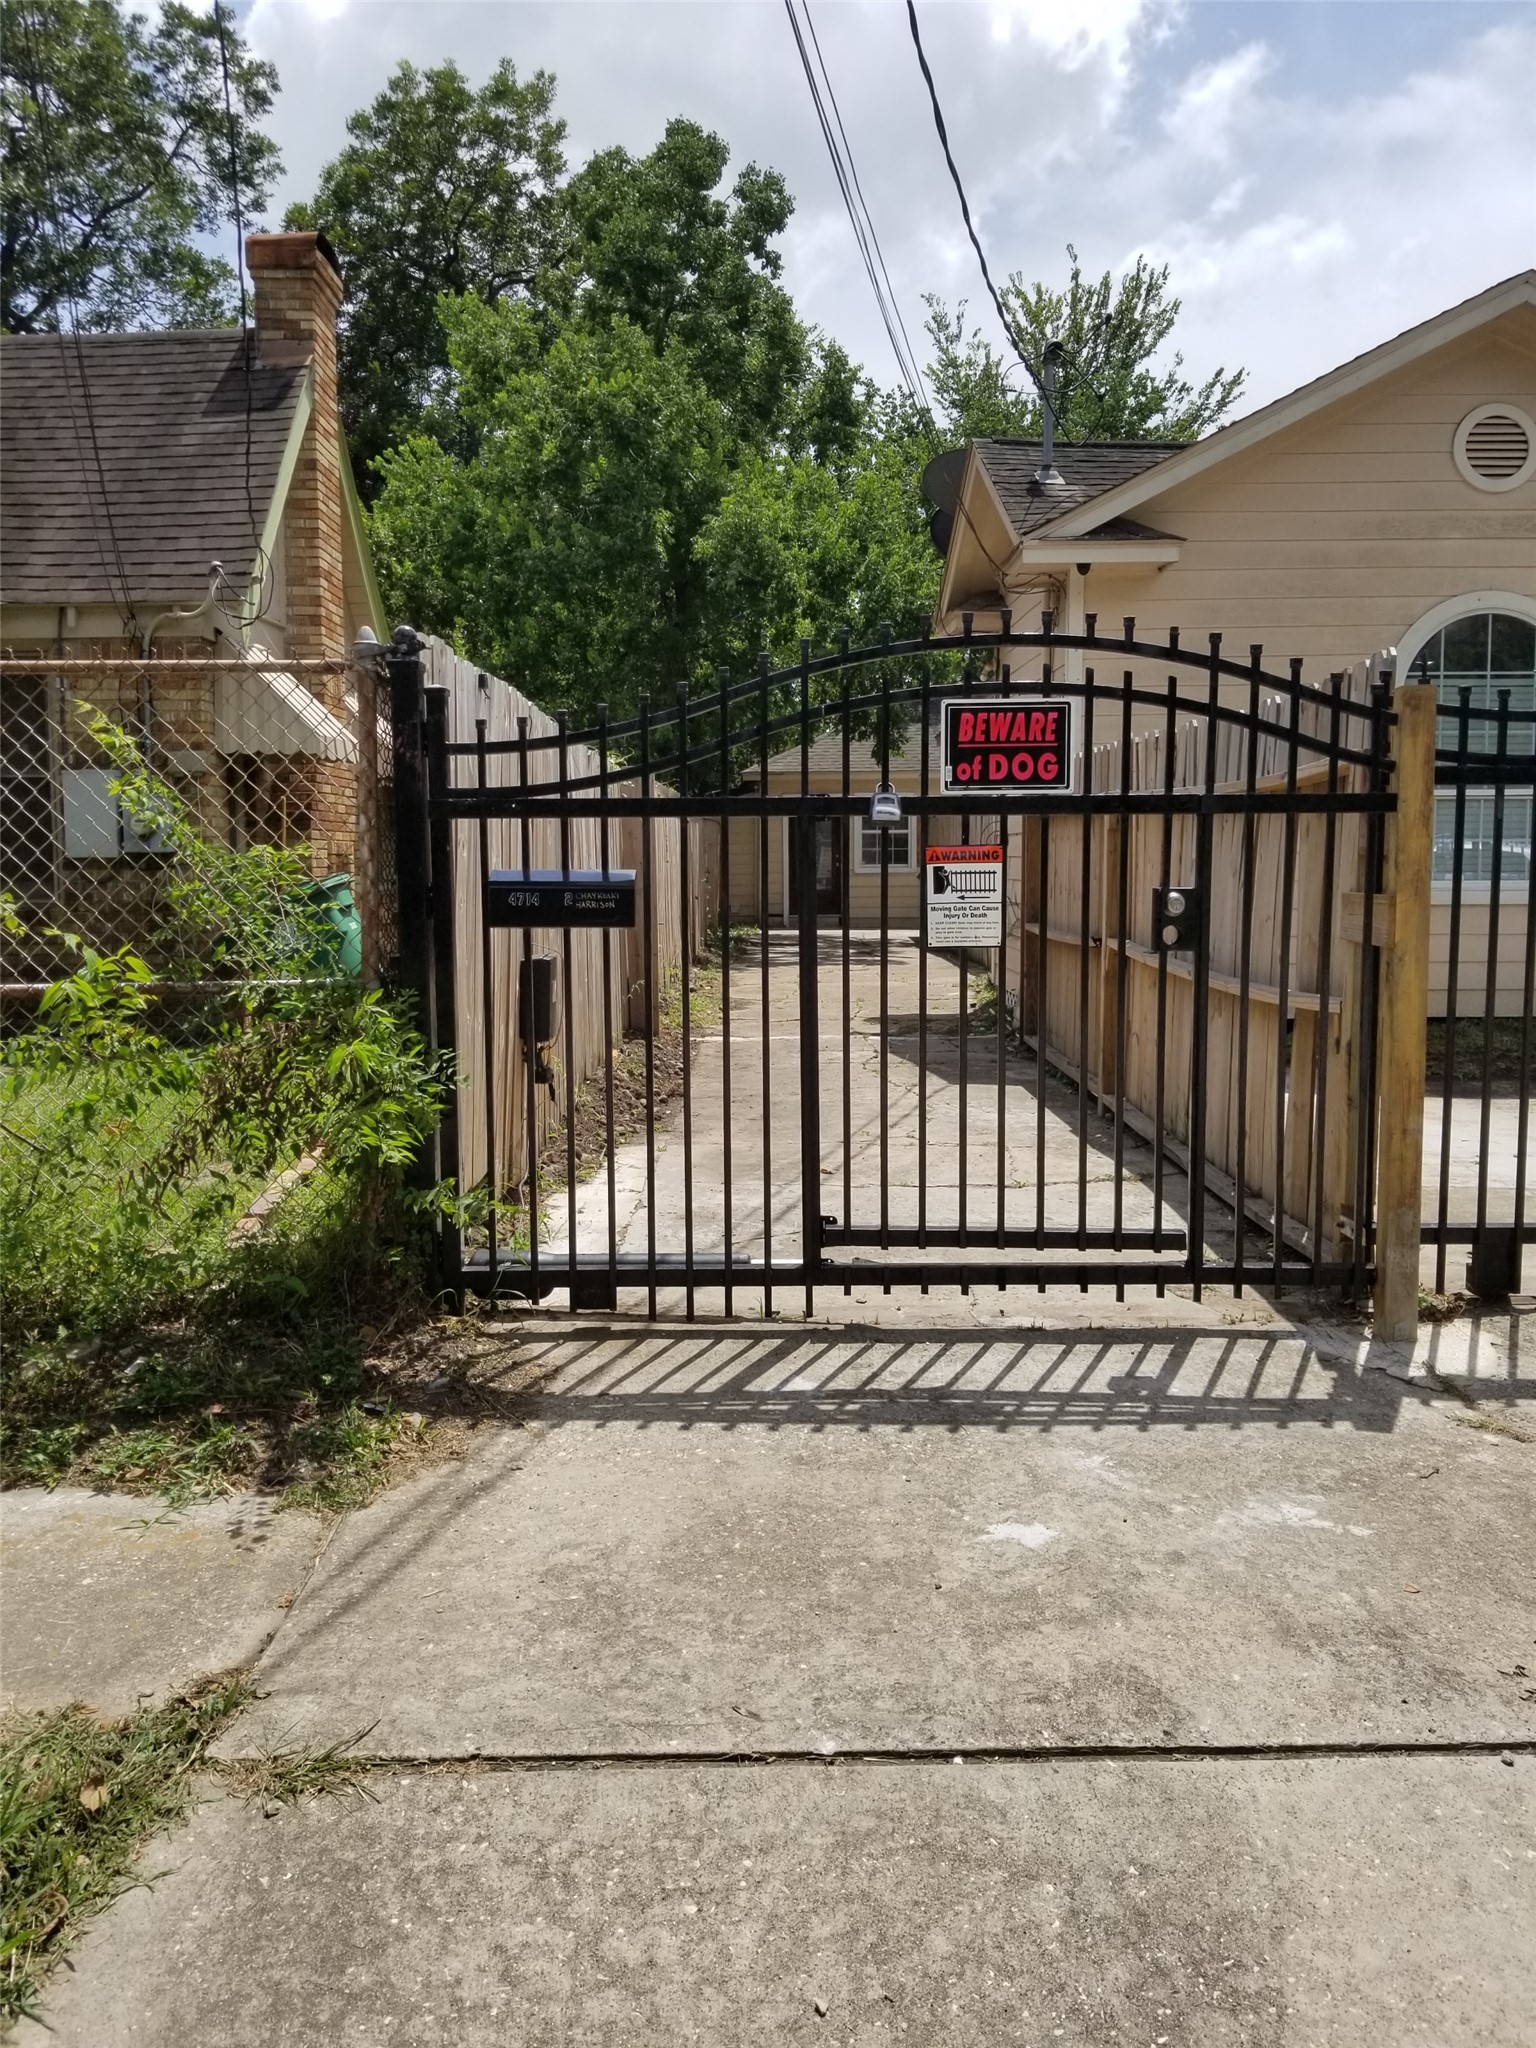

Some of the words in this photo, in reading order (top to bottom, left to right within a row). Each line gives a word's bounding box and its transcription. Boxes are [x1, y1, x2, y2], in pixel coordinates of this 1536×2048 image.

[958, 712, 1058, 742] BEWARE
[956, 755, 982, 780] of
[988, 752, 1059, 780] DOG
[941, 850, 1000, 861] WARNING
[508, 892, 540, 906] 4714
[564, 892, 573, 906] 2
[575, 900, 616, 909] HARRISON
